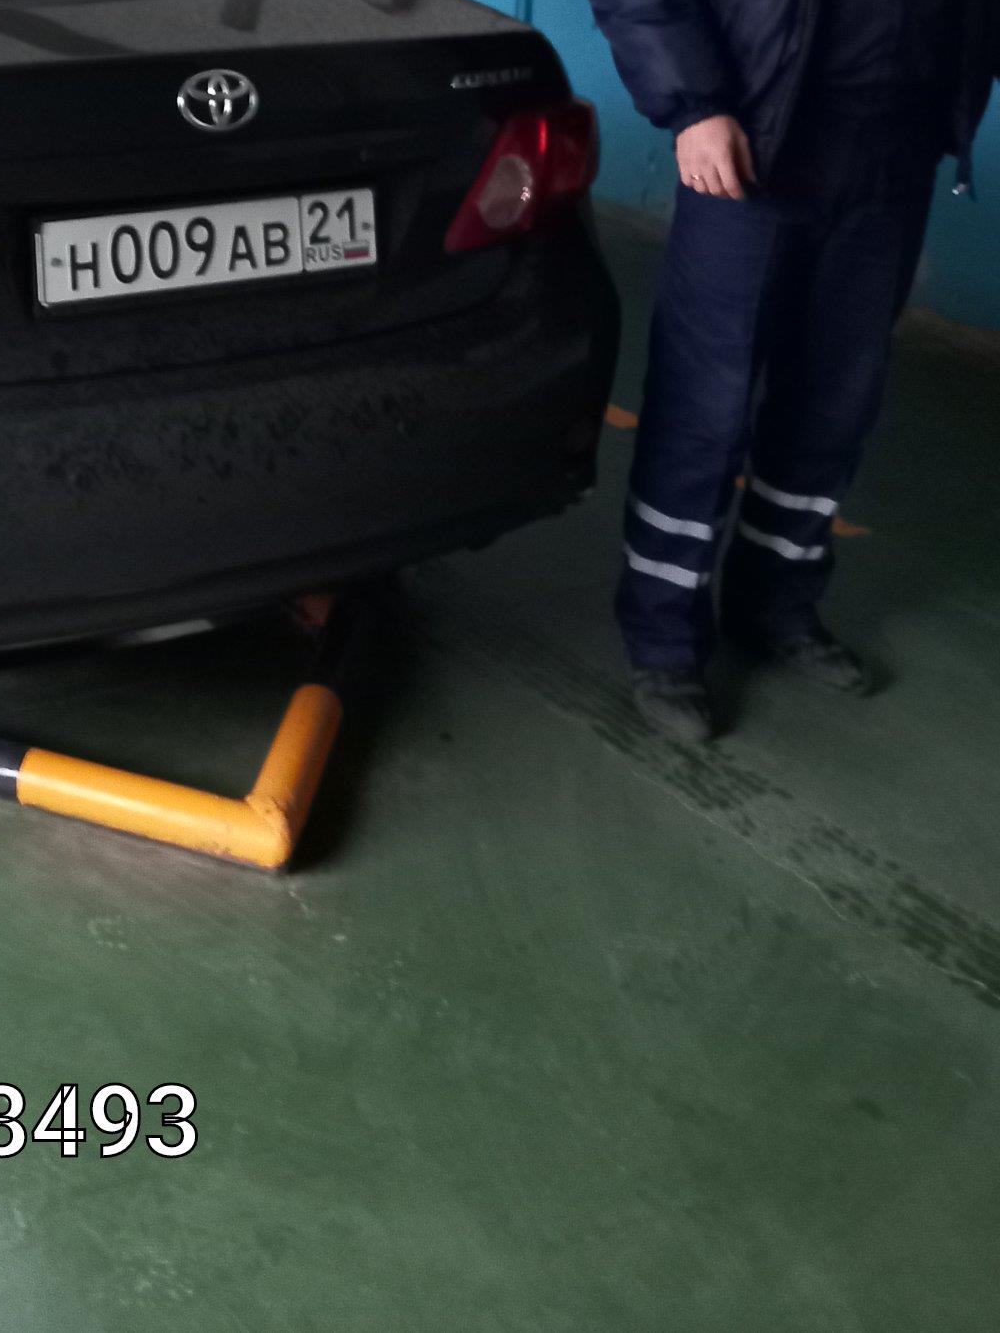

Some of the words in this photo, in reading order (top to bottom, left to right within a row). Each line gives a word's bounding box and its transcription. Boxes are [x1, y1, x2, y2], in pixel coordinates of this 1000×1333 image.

[68, 217, 291, 292] H009AB
[307, 197, 357, 245] 21
[304, 246, 342, 265] RUS
